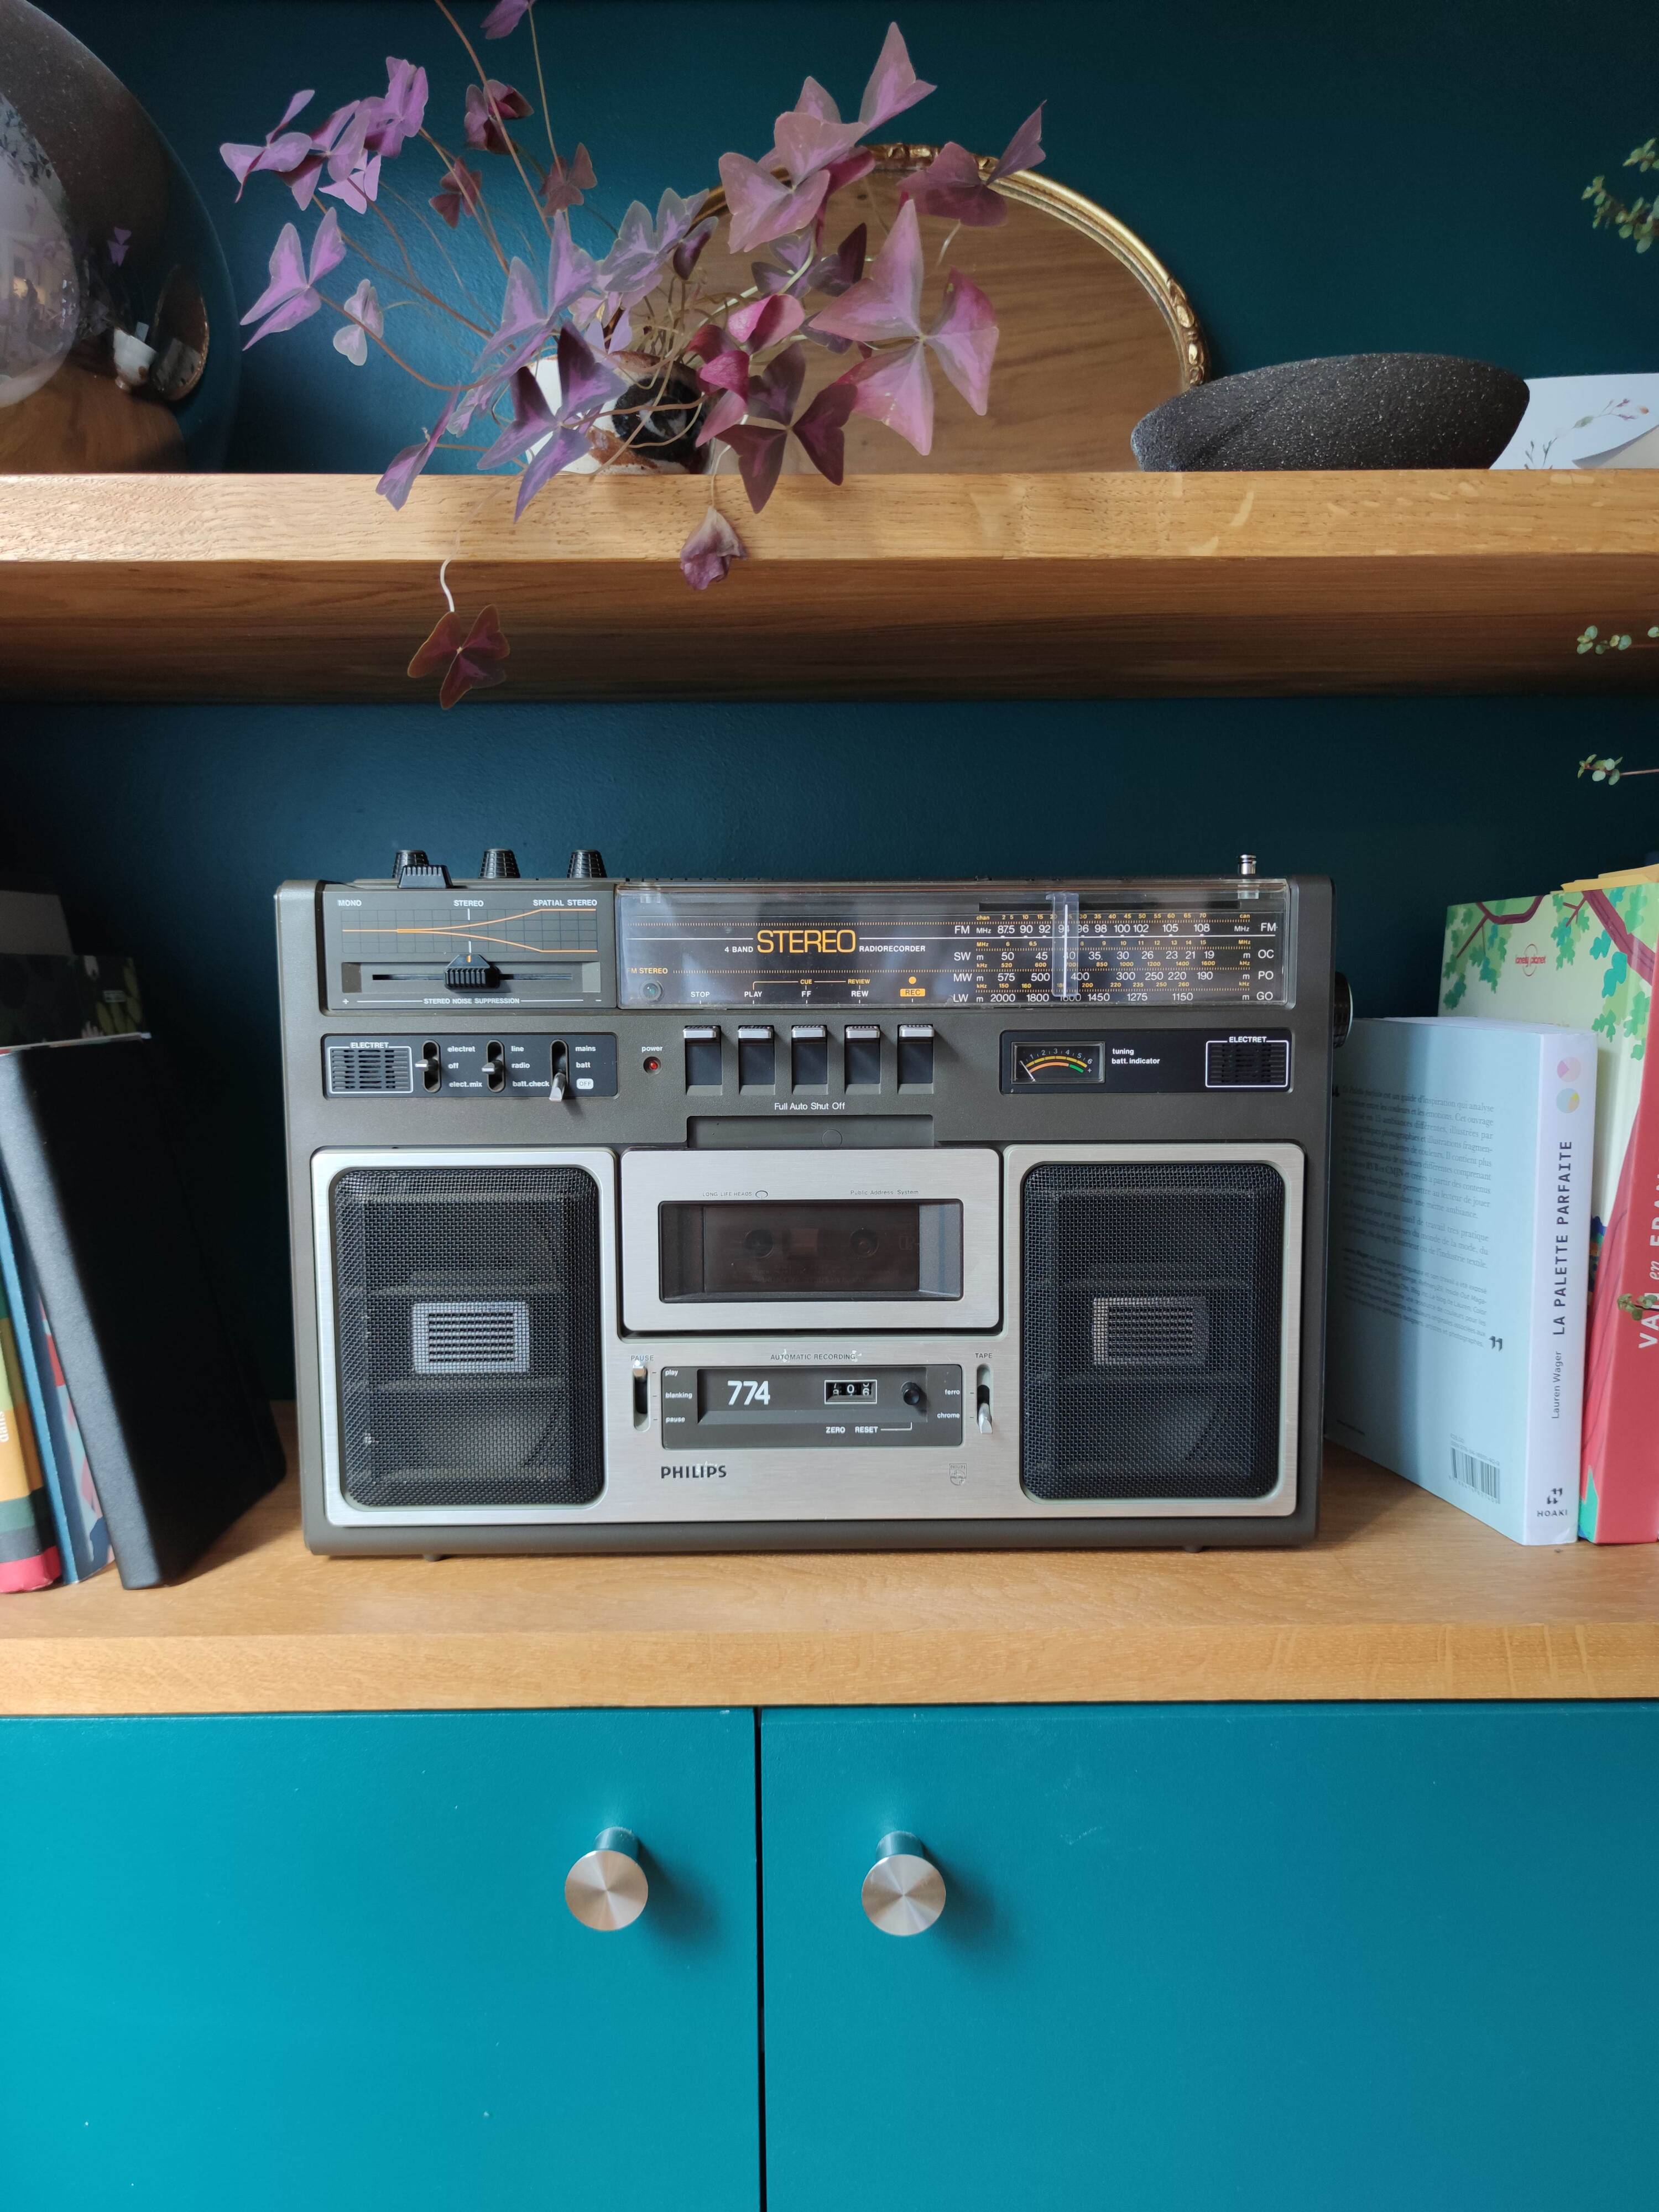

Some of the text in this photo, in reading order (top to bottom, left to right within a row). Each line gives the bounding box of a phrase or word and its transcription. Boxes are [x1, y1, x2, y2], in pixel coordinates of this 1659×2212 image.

[954, 925, 970, 934] FM
[997, 925, 1015, 933] 87.5
[1020, 925, 1033, 933] 90
[1039, 925, 1051, 933] 92
[1077, 925, 1089, 933] 96
[1094, 925, 1107, 933] 98
[1113, 924, 1131, 933] 100
[1133, 924, 1149, 933] 102
[1162, 924, 1179, 932] 105
[1193, 924, 1210, 932] 108
[1260, 923, 1277, 932] FM
[757, 930, 855, 953] STEREO
[953, 952, 971, 961] SW
[1001, 952, 1015, 961] 50
[1035, 952, 1048, 960] 45
[1117, 951, 1129, 960] 30
[1141, 951, 1154, 960] 26
[1166, 951, 1178, 959] 23
[1186, 951, 1195, 959] 21
[1204, 951, 1215, 959] 19
[1258, 950, 1274, 959] OC
[953, 971, 1274, 982] MW 575 500 400 300 250 220 190 PO
[953, 992, 1273, 1003] LW 2000 1800 1600 1450 1275 1150 GO
[1551, 1141, 1572, 1419] Lauren Wager LA PALETTE PARFAITE
[727, 1380, 771, 1405] 774
[661, 1465, 727, 1479] PHILIPS
[1536, 1509, 1568, 1517] HOAKI
